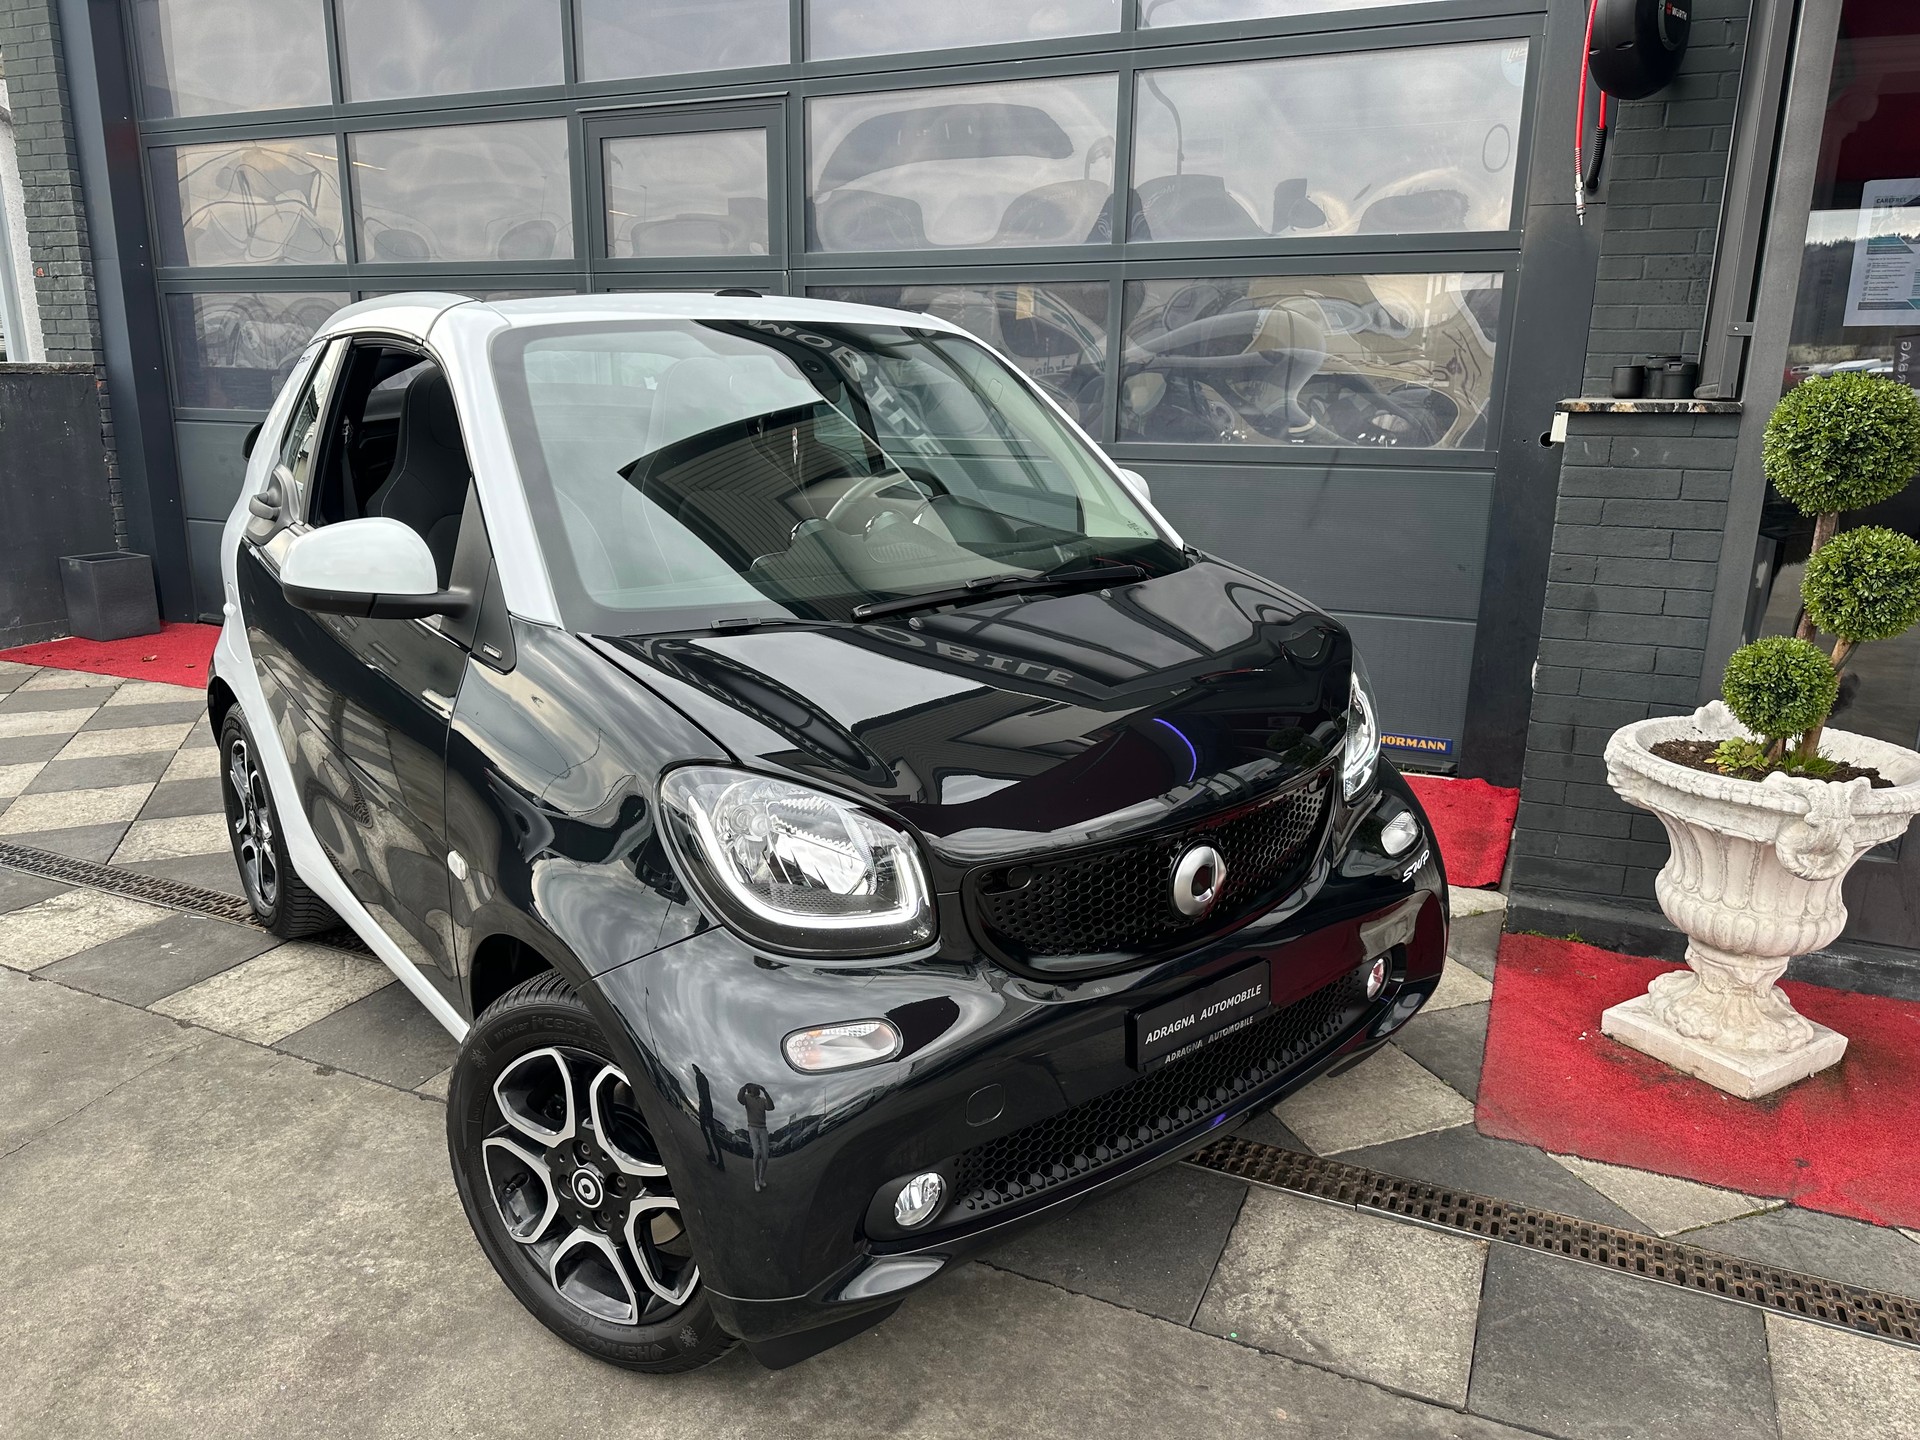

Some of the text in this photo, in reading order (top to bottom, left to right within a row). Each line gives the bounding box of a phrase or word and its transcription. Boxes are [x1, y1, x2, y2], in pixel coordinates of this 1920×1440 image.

[1380, 735, 1446, 751] HÖRMANN
[1145, 984, 1262, 1045] ADRAGNA AUTOMOBILE
[1164, 1015, 1254, 1064] ADRAGNA AUTOMOBILE
